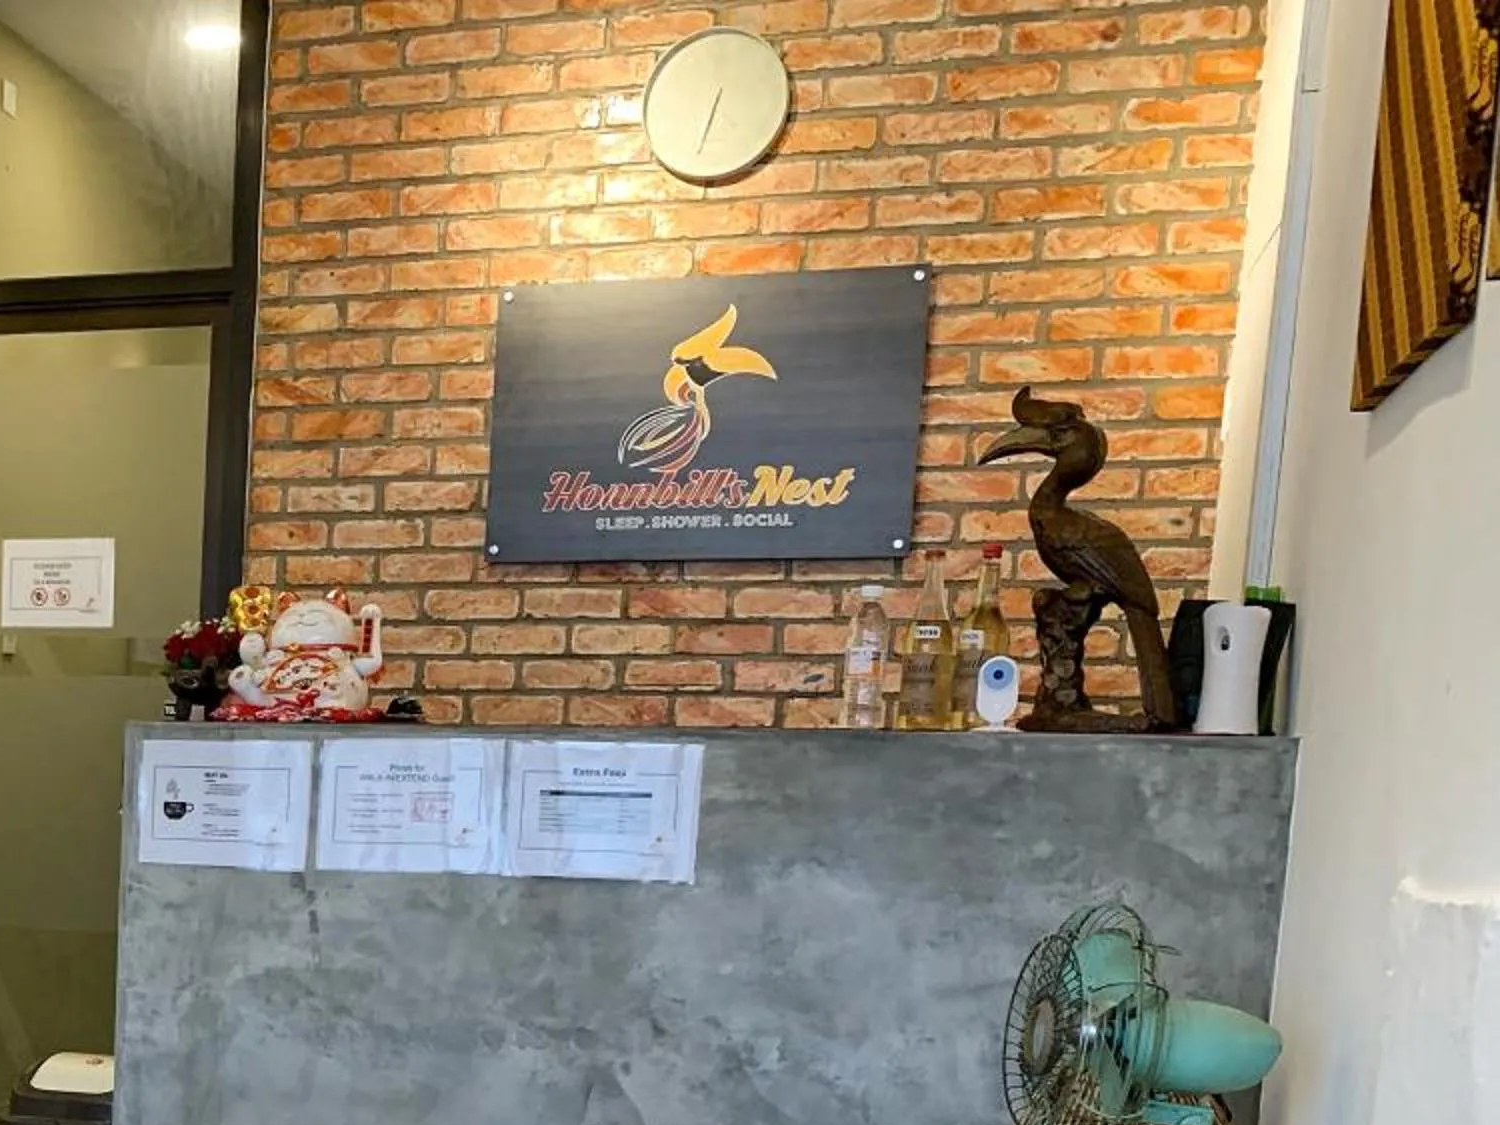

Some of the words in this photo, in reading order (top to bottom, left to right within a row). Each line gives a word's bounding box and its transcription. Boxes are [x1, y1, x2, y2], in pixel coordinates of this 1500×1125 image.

[746, 465, 855, 508] Nest
[732, 513, 794, 528] SOCIAL
[573, 767, 601, 777] Extra
